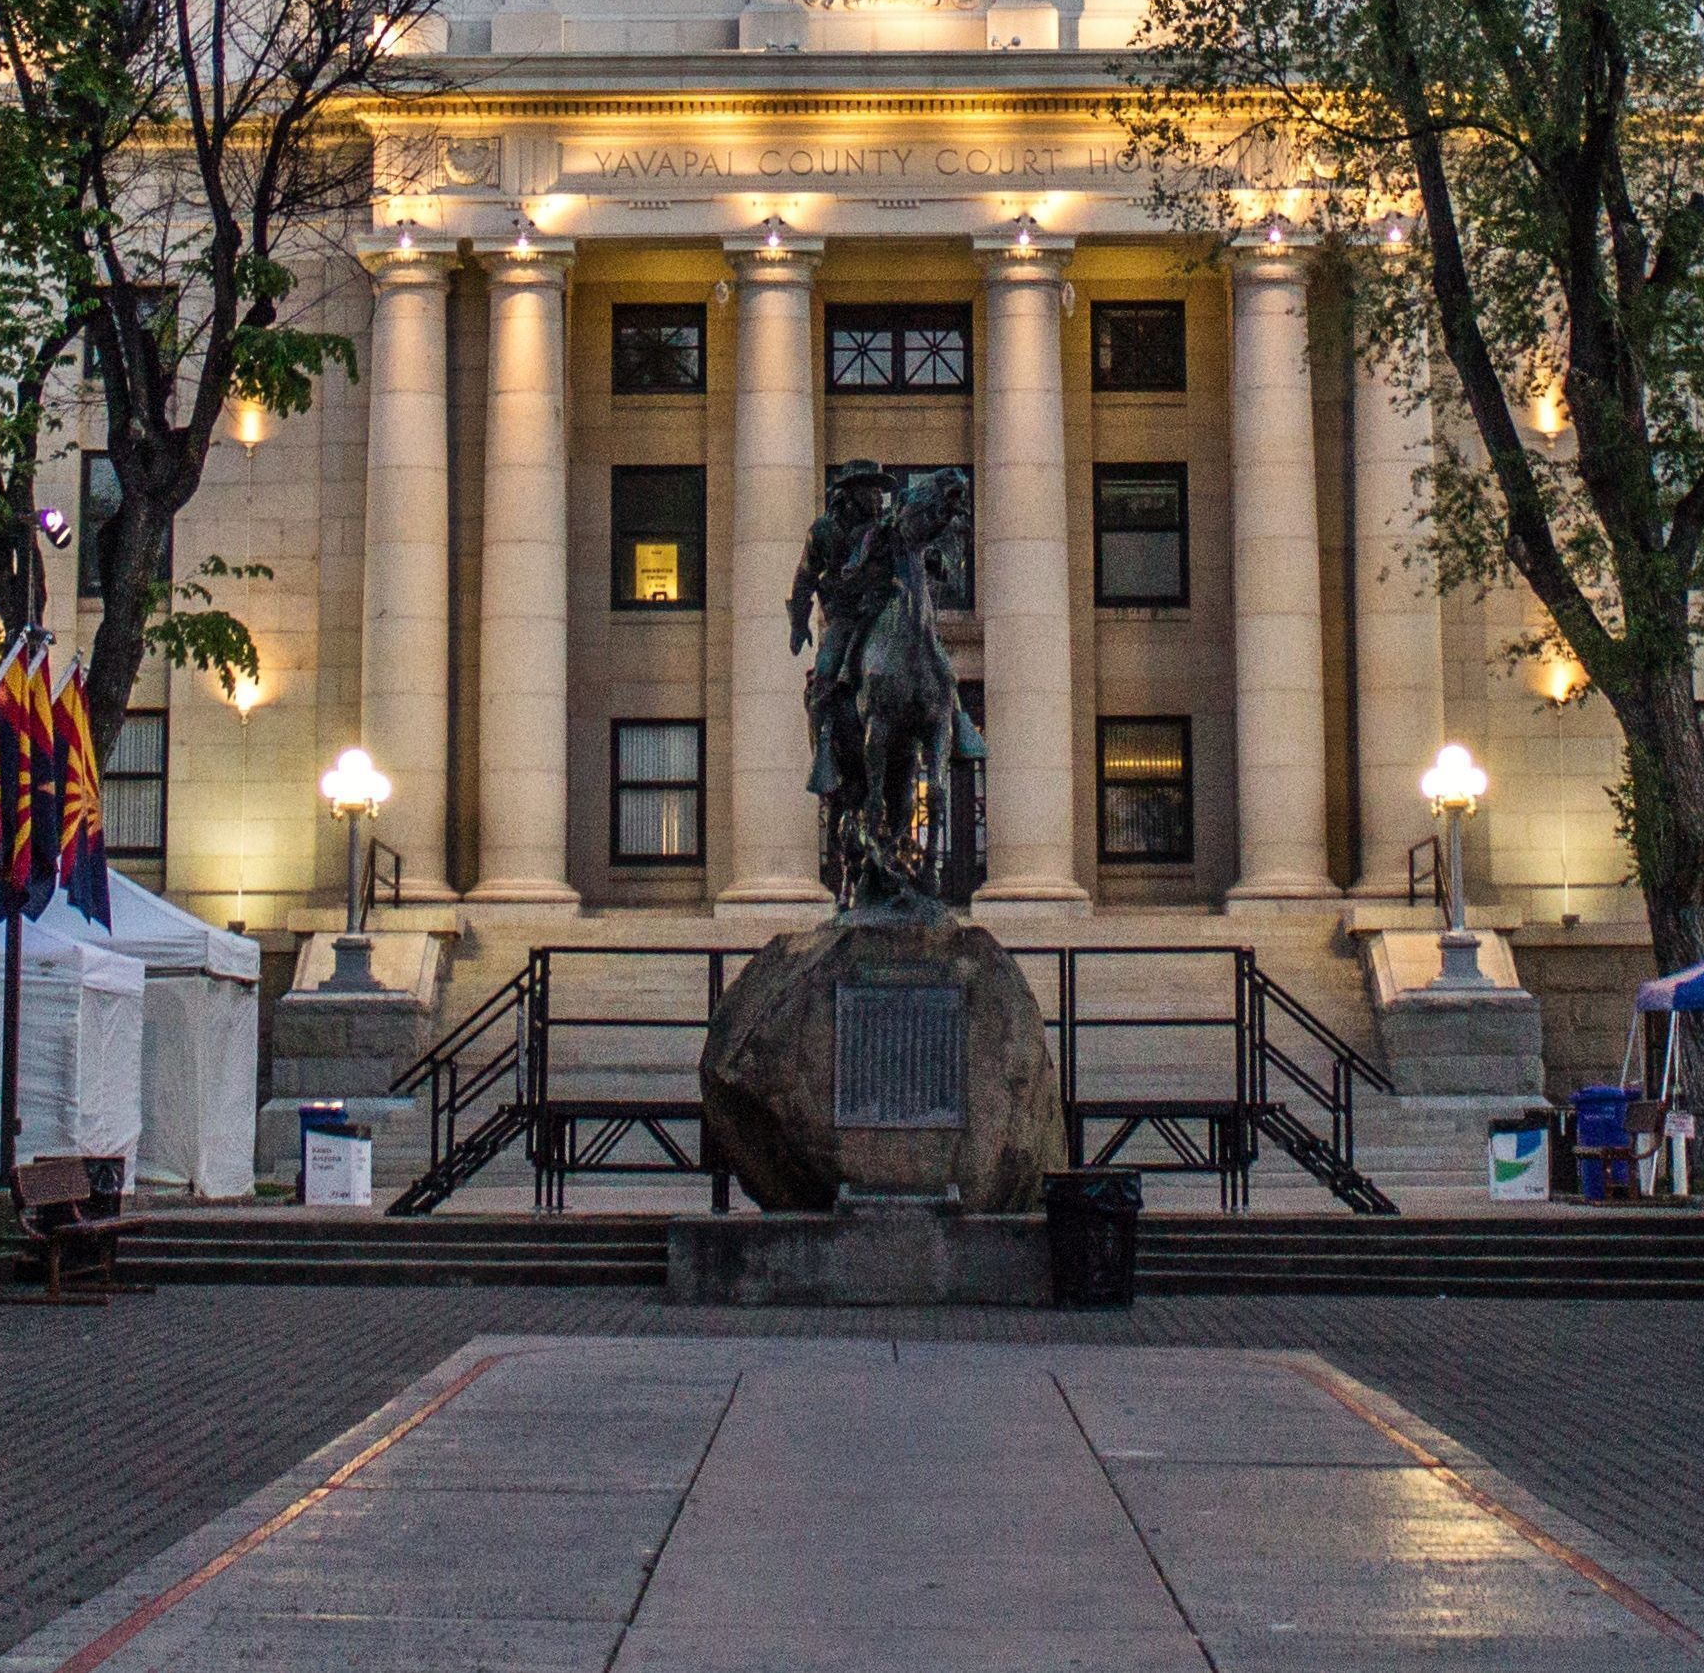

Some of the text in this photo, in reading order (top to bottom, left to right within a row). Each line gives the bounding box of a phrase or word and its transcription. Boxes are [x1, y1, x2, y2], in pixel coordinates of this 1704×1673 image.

[594, 150, 732, 177] YAVAPAI
[758, 149, 912, 176] COUNTY
[935, 148, 1062, 176] COURT
